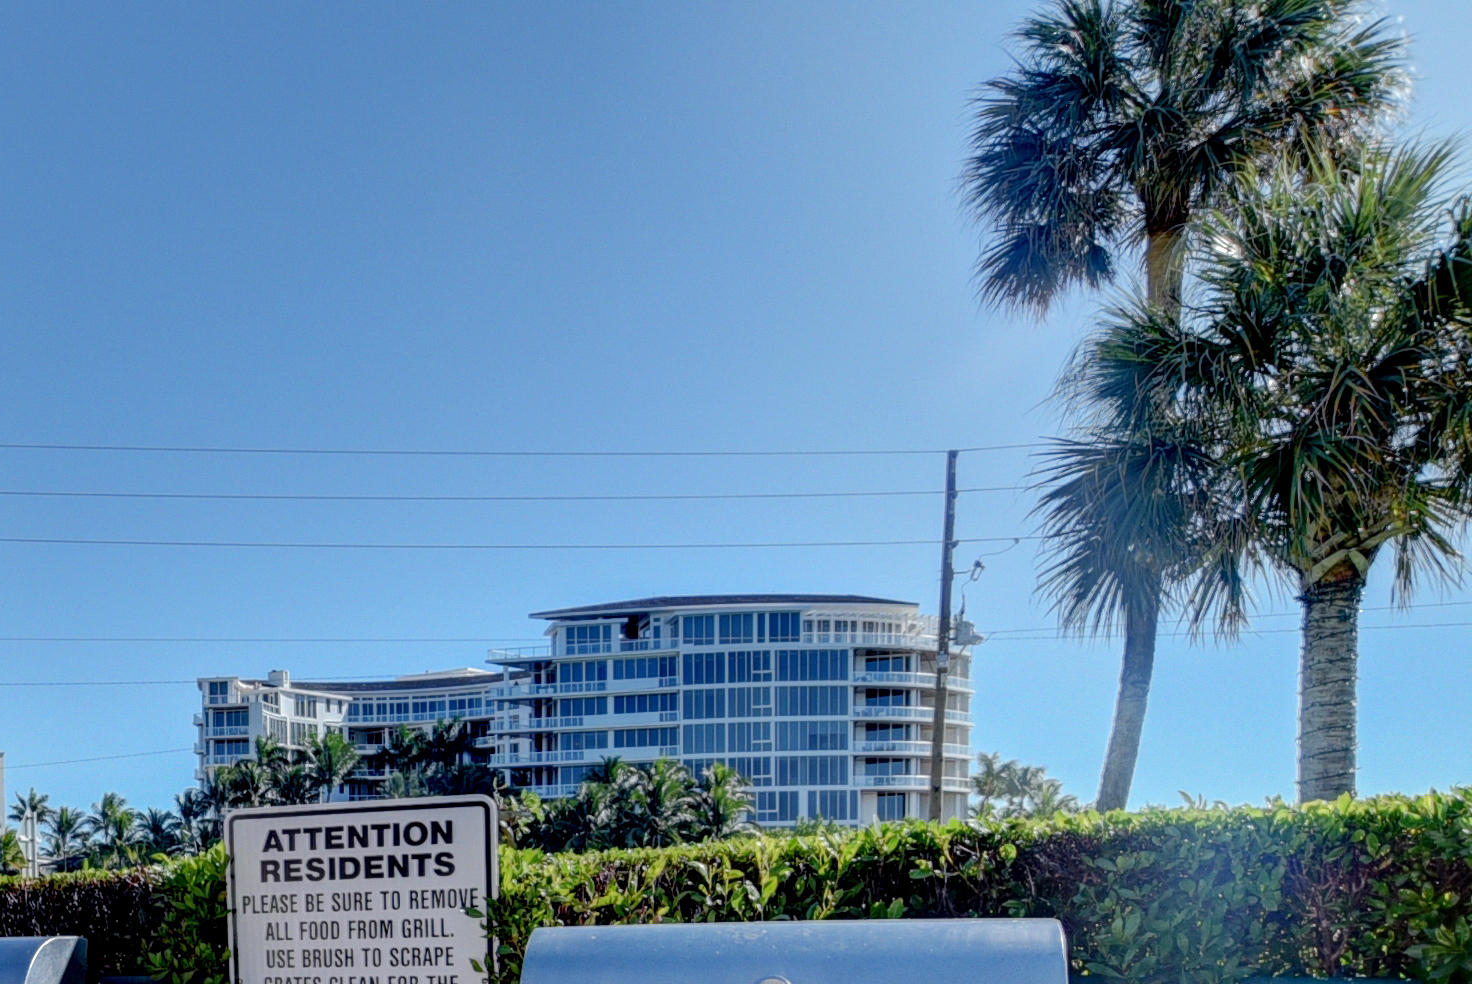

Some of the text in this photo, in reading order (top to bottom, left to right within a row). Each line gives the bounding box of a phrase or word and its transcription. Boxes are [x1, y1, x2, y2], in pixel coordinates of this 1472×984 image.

[262, 820, 453, 852] ATTENTION
[260, 852, 455, 882] RESIDENTS
[242, 888, 479, 914] PLEASE BE SURE TO REMOVE
[266, 918, 454, 941] ALL FOOD FROM GRILL.
[266, 947, 454, 968] USE BRUSH TO SCRAPE
